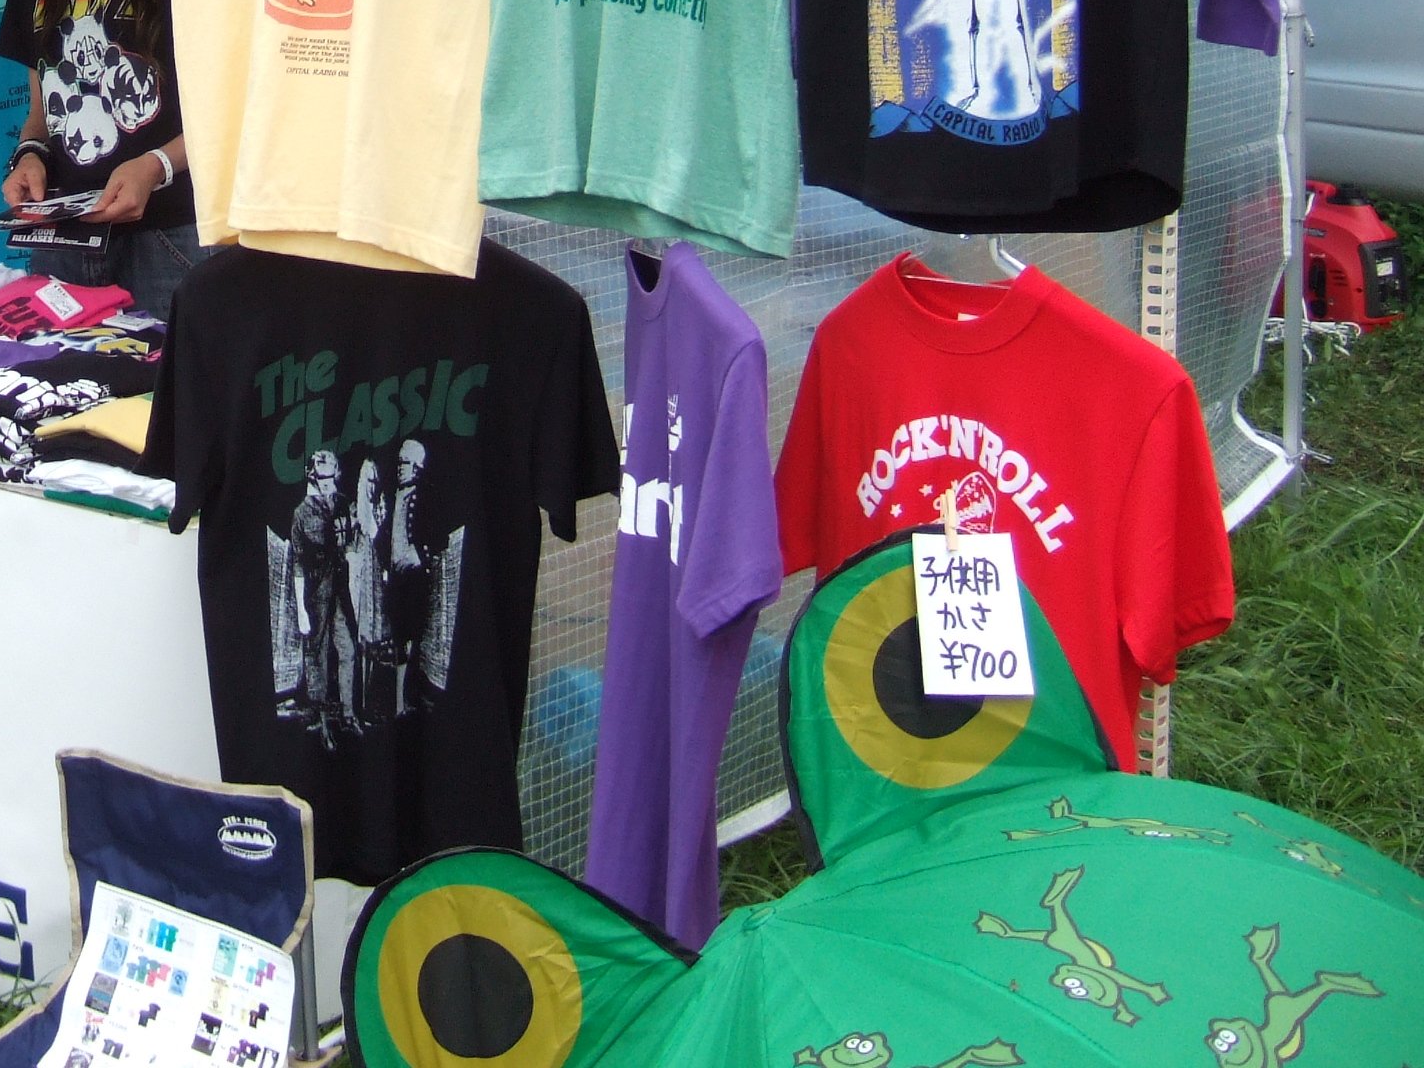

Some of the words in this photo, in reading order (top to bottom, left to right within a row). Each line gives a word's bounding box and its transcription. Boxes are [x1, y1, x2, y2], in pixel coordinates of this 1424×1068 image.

[933, 104, 995, 142] CAPITAL
[255, 350, 339, 419] The
[272, 359, 490, 485] CLASSIC
[920, 556, 1001, 596] 子供用
[936, 602, 992, 631] かさ
[939, 637, 1018, 682] ¥700
